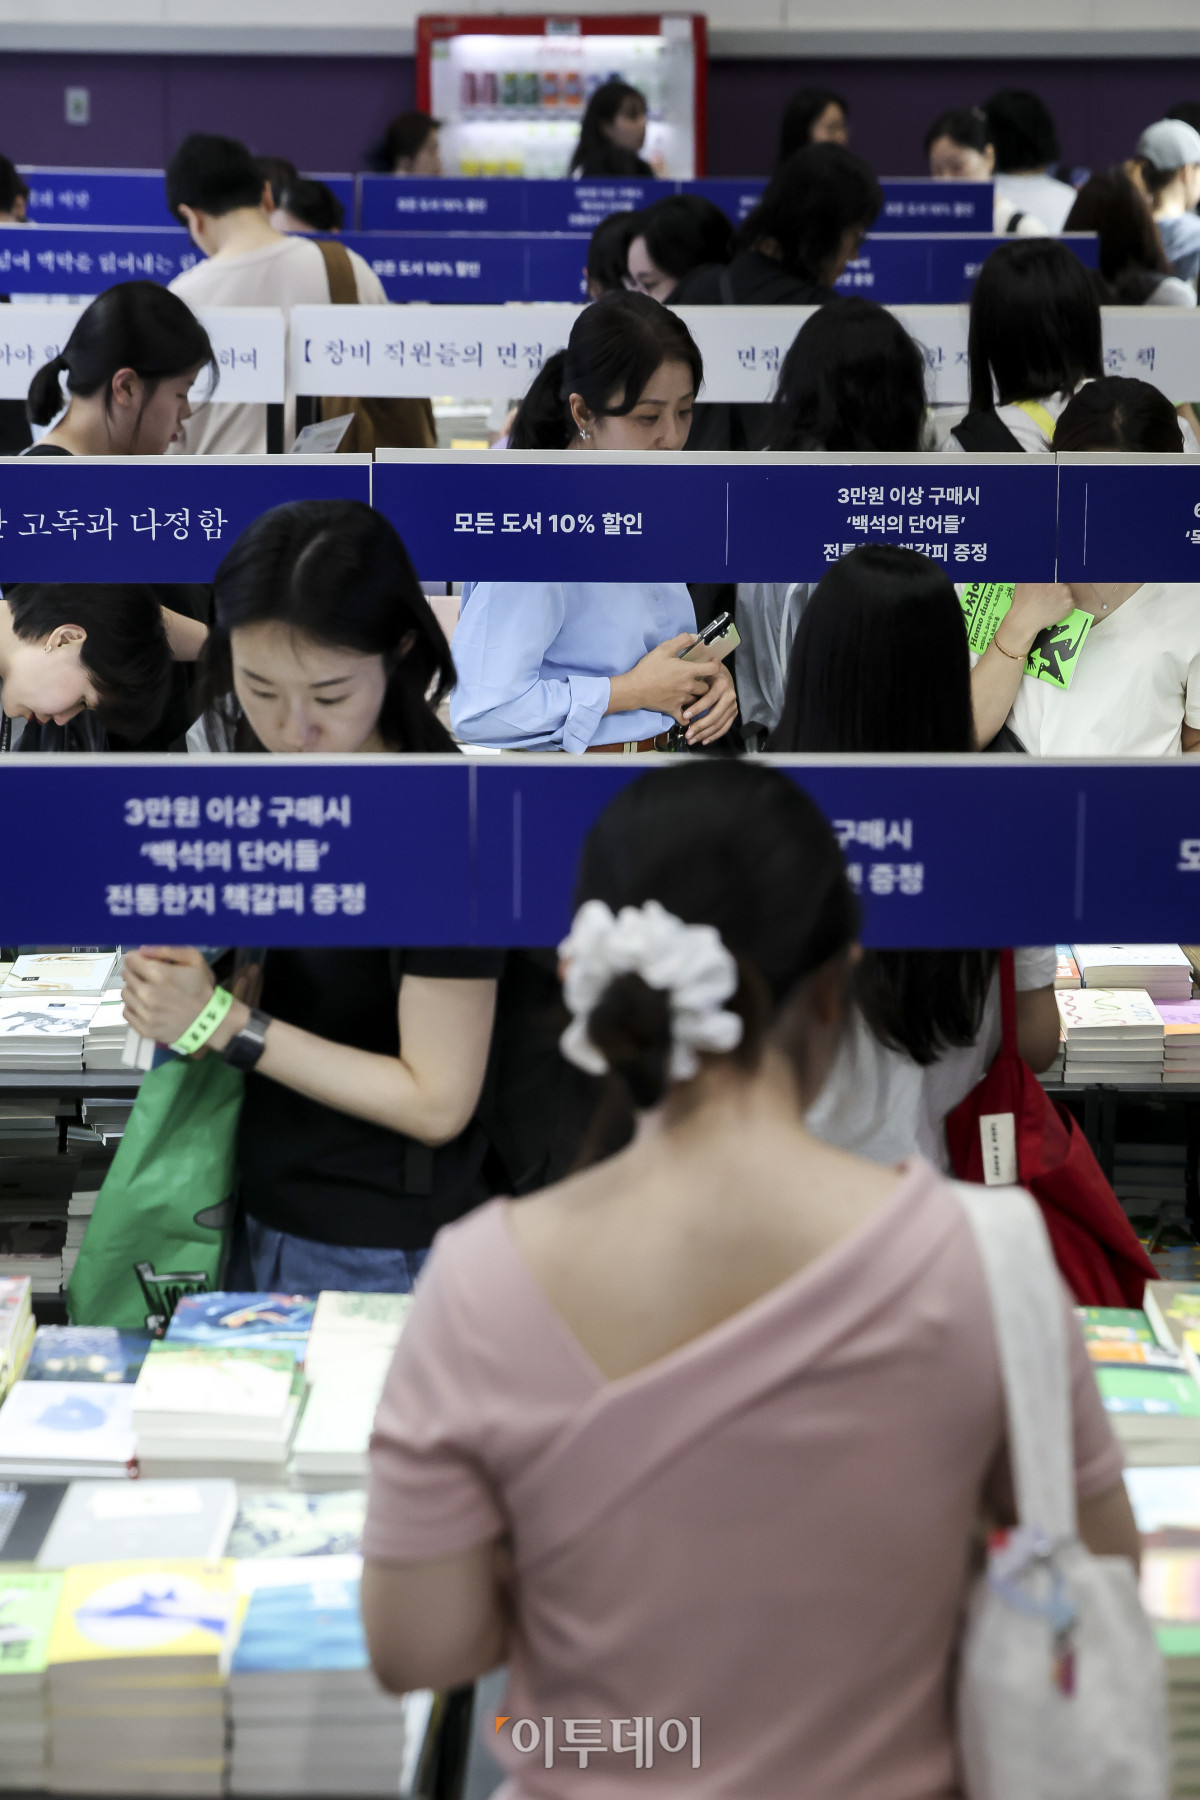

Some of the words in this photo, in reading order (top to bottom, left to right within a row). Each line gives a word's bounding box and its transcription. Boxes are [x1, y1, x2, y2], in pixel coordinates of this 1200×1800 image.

[325, 339, 371, 366] 창비
[385, 340, 484, 367] 직원들의
[837, 486, 885, 506] 3만원
[889, 486, 925, 506] 이상
[928, 486, 980, 506] 구매시
[18, 507, 118, 541] 고독과
[130, 507, 228, 541] 다정함
[454, 512, 496, 535] 모든
[501, 512, 542, 535] 도서
[549, 513, 596, 534] 10%
[602, 512, 643, 535] 할인
[953, 543, 988, 562] 증정
[970, 614, 985, 647] Homo
[125, 795, 200, 828] 3만원
[206, 795, 263, 828] 이상
[267, 795, 351, 828] 구매시
[832, 818, 912, 851] 구매시
[869, 862, 924, 895] 증정
[106, 883, 215, 915] 전통한지
[222, 883, 304, 915] 책갈피
[311, 883, 366, 915] 증정
